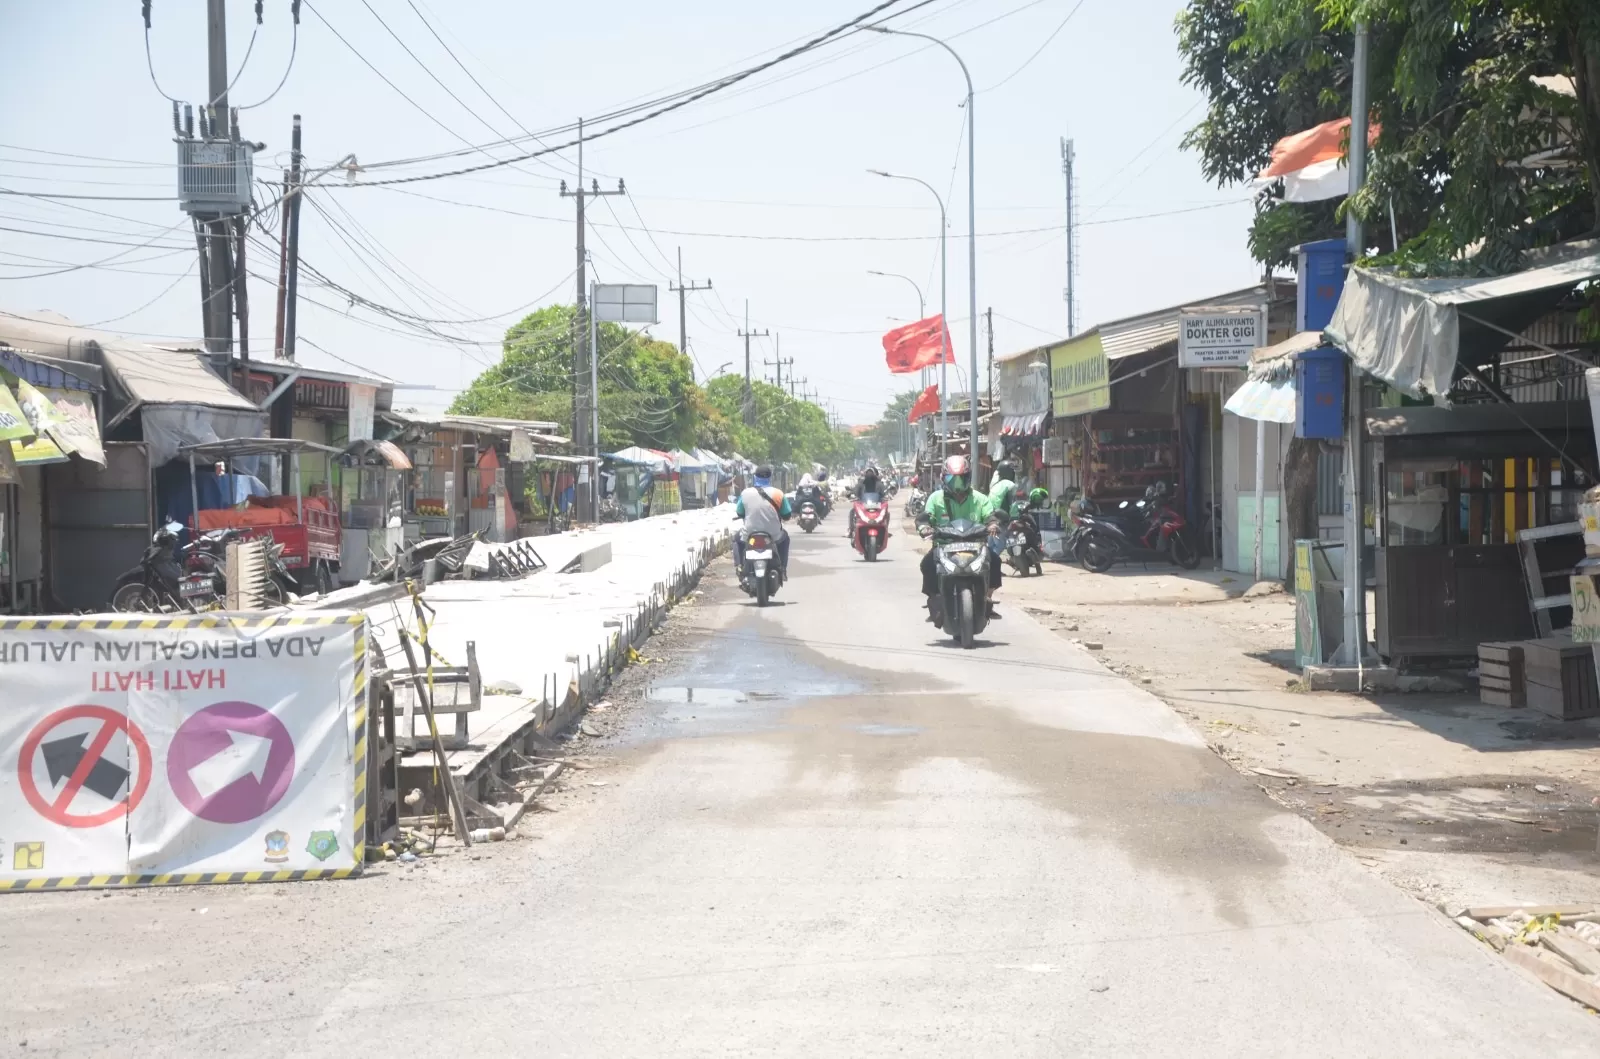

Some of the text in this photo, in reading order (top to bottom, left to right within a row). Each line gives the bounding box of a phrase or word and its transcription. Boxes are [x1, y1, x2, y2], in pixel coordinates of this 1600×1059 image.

[1186, 319, 1204, 328] HARY
[1186, 326, 1255, 339] DOKTER GIGI
[94, 639, 258, 662] PENGALIAN
[263, 636, 325, 658] ADA
[91, 669, 226, 692] HATI HATI
